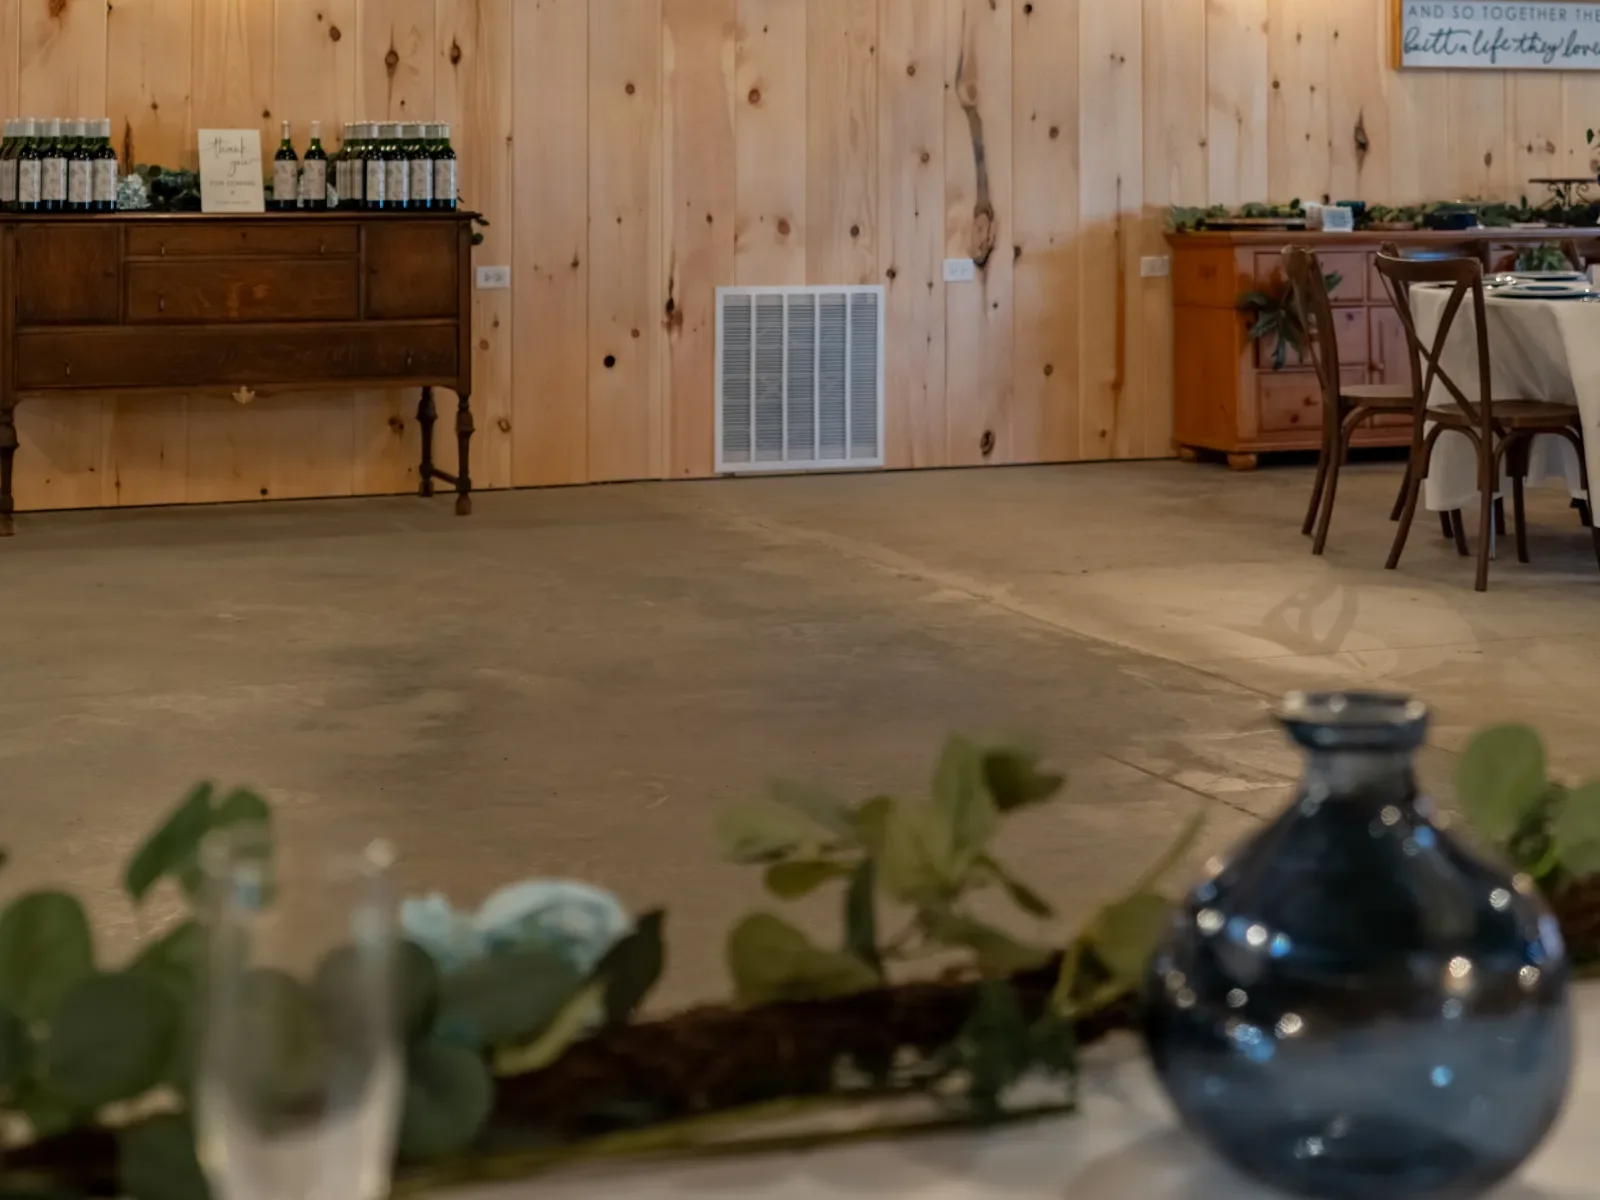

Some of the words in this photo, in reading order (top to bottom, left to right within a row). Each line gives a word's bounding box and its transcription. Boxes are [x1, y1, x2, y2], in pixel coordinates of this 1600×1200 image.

[1408, 4, 1445, 19] AND
[1452, 5, 1475, 20] SO
[1482, 5, 1567, 22] TOGETHER
[1472, 27, 1512, 65] life
[1511, 31, 1565, 65] they
